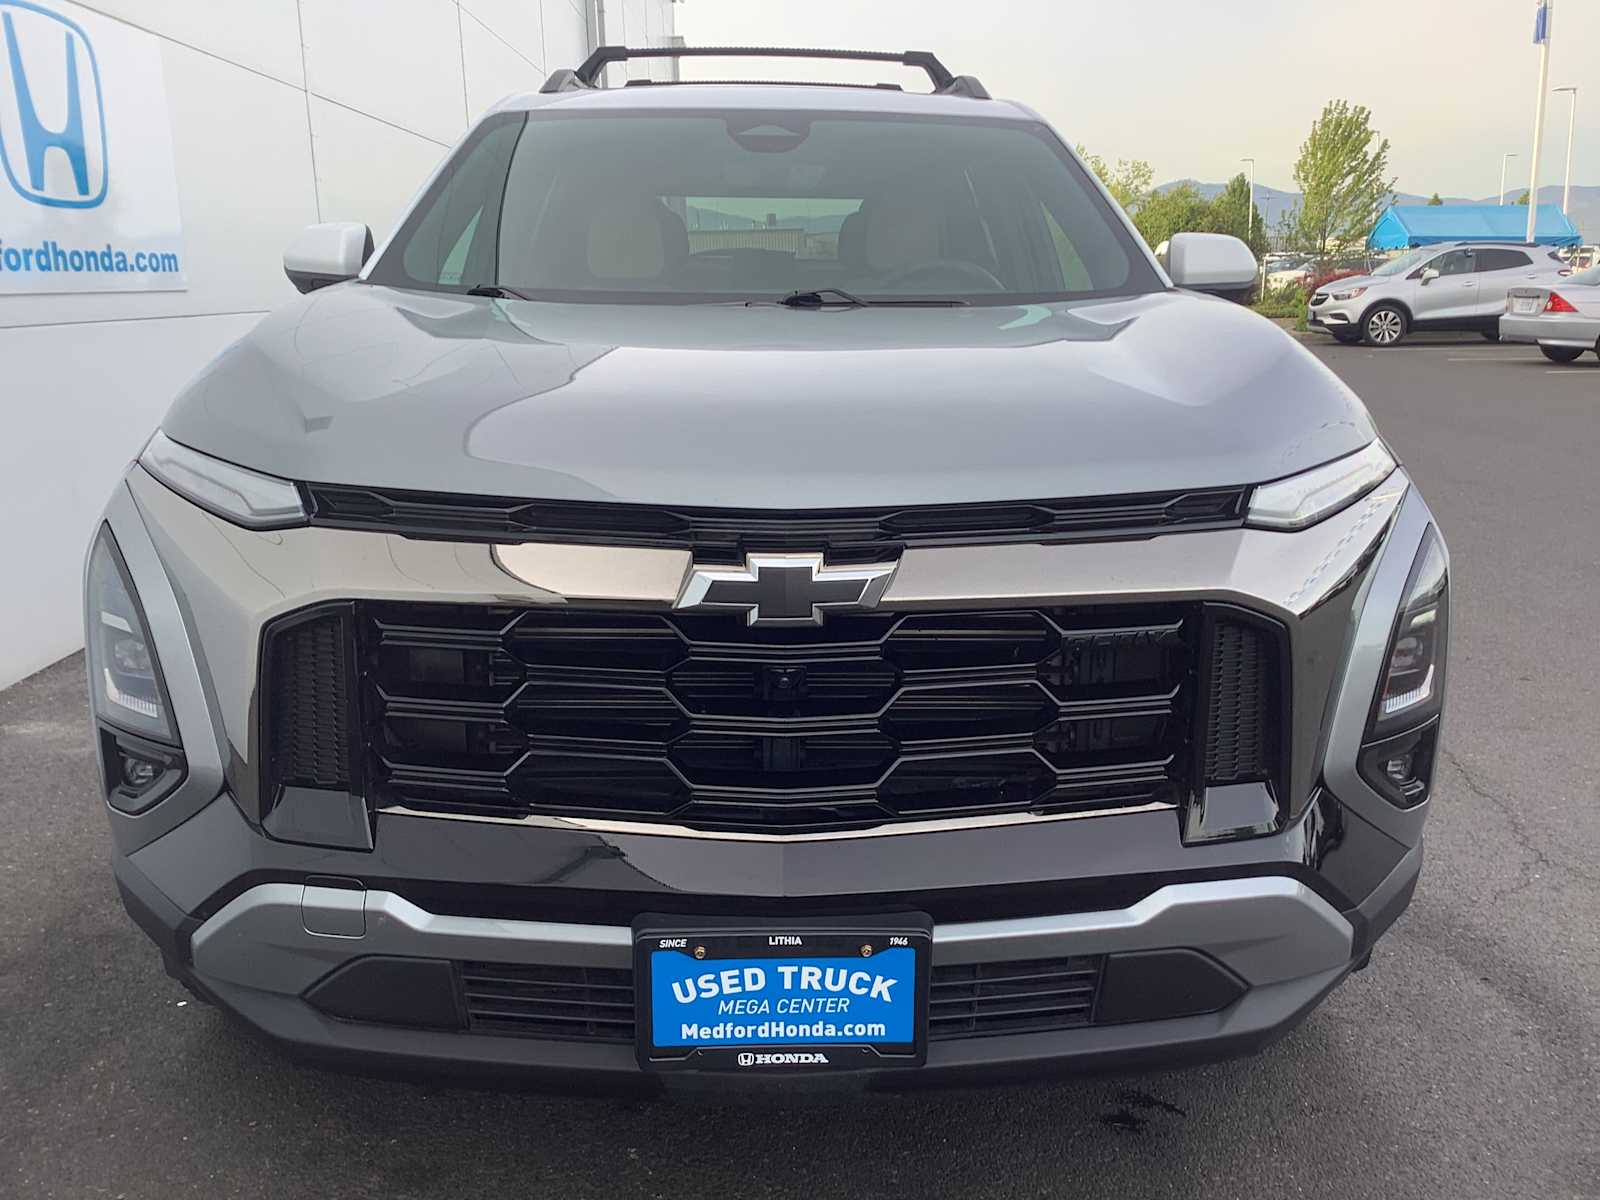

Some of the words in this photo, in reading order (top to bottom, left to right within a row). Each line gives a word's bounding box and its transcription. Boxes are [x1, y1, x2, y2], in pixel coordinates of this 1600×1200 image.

[0, 239, 179, 273] ordhonda.com
[659, 938, 687, 949] SINCE
[768, 936, 802, 946] LITHIA
[889, 936, 908, 946] 1946
[672, 967, 766, 1004] USED
[777, 966, 898, 1003] TRUCK
[718, 1000, 770, 1015] MEGA
[776, 998, 850, 1014] CENTER
[681, 1021, 886, 1040] MedfordHonda.com
[755, 1053, 829, 1064] HONDA
